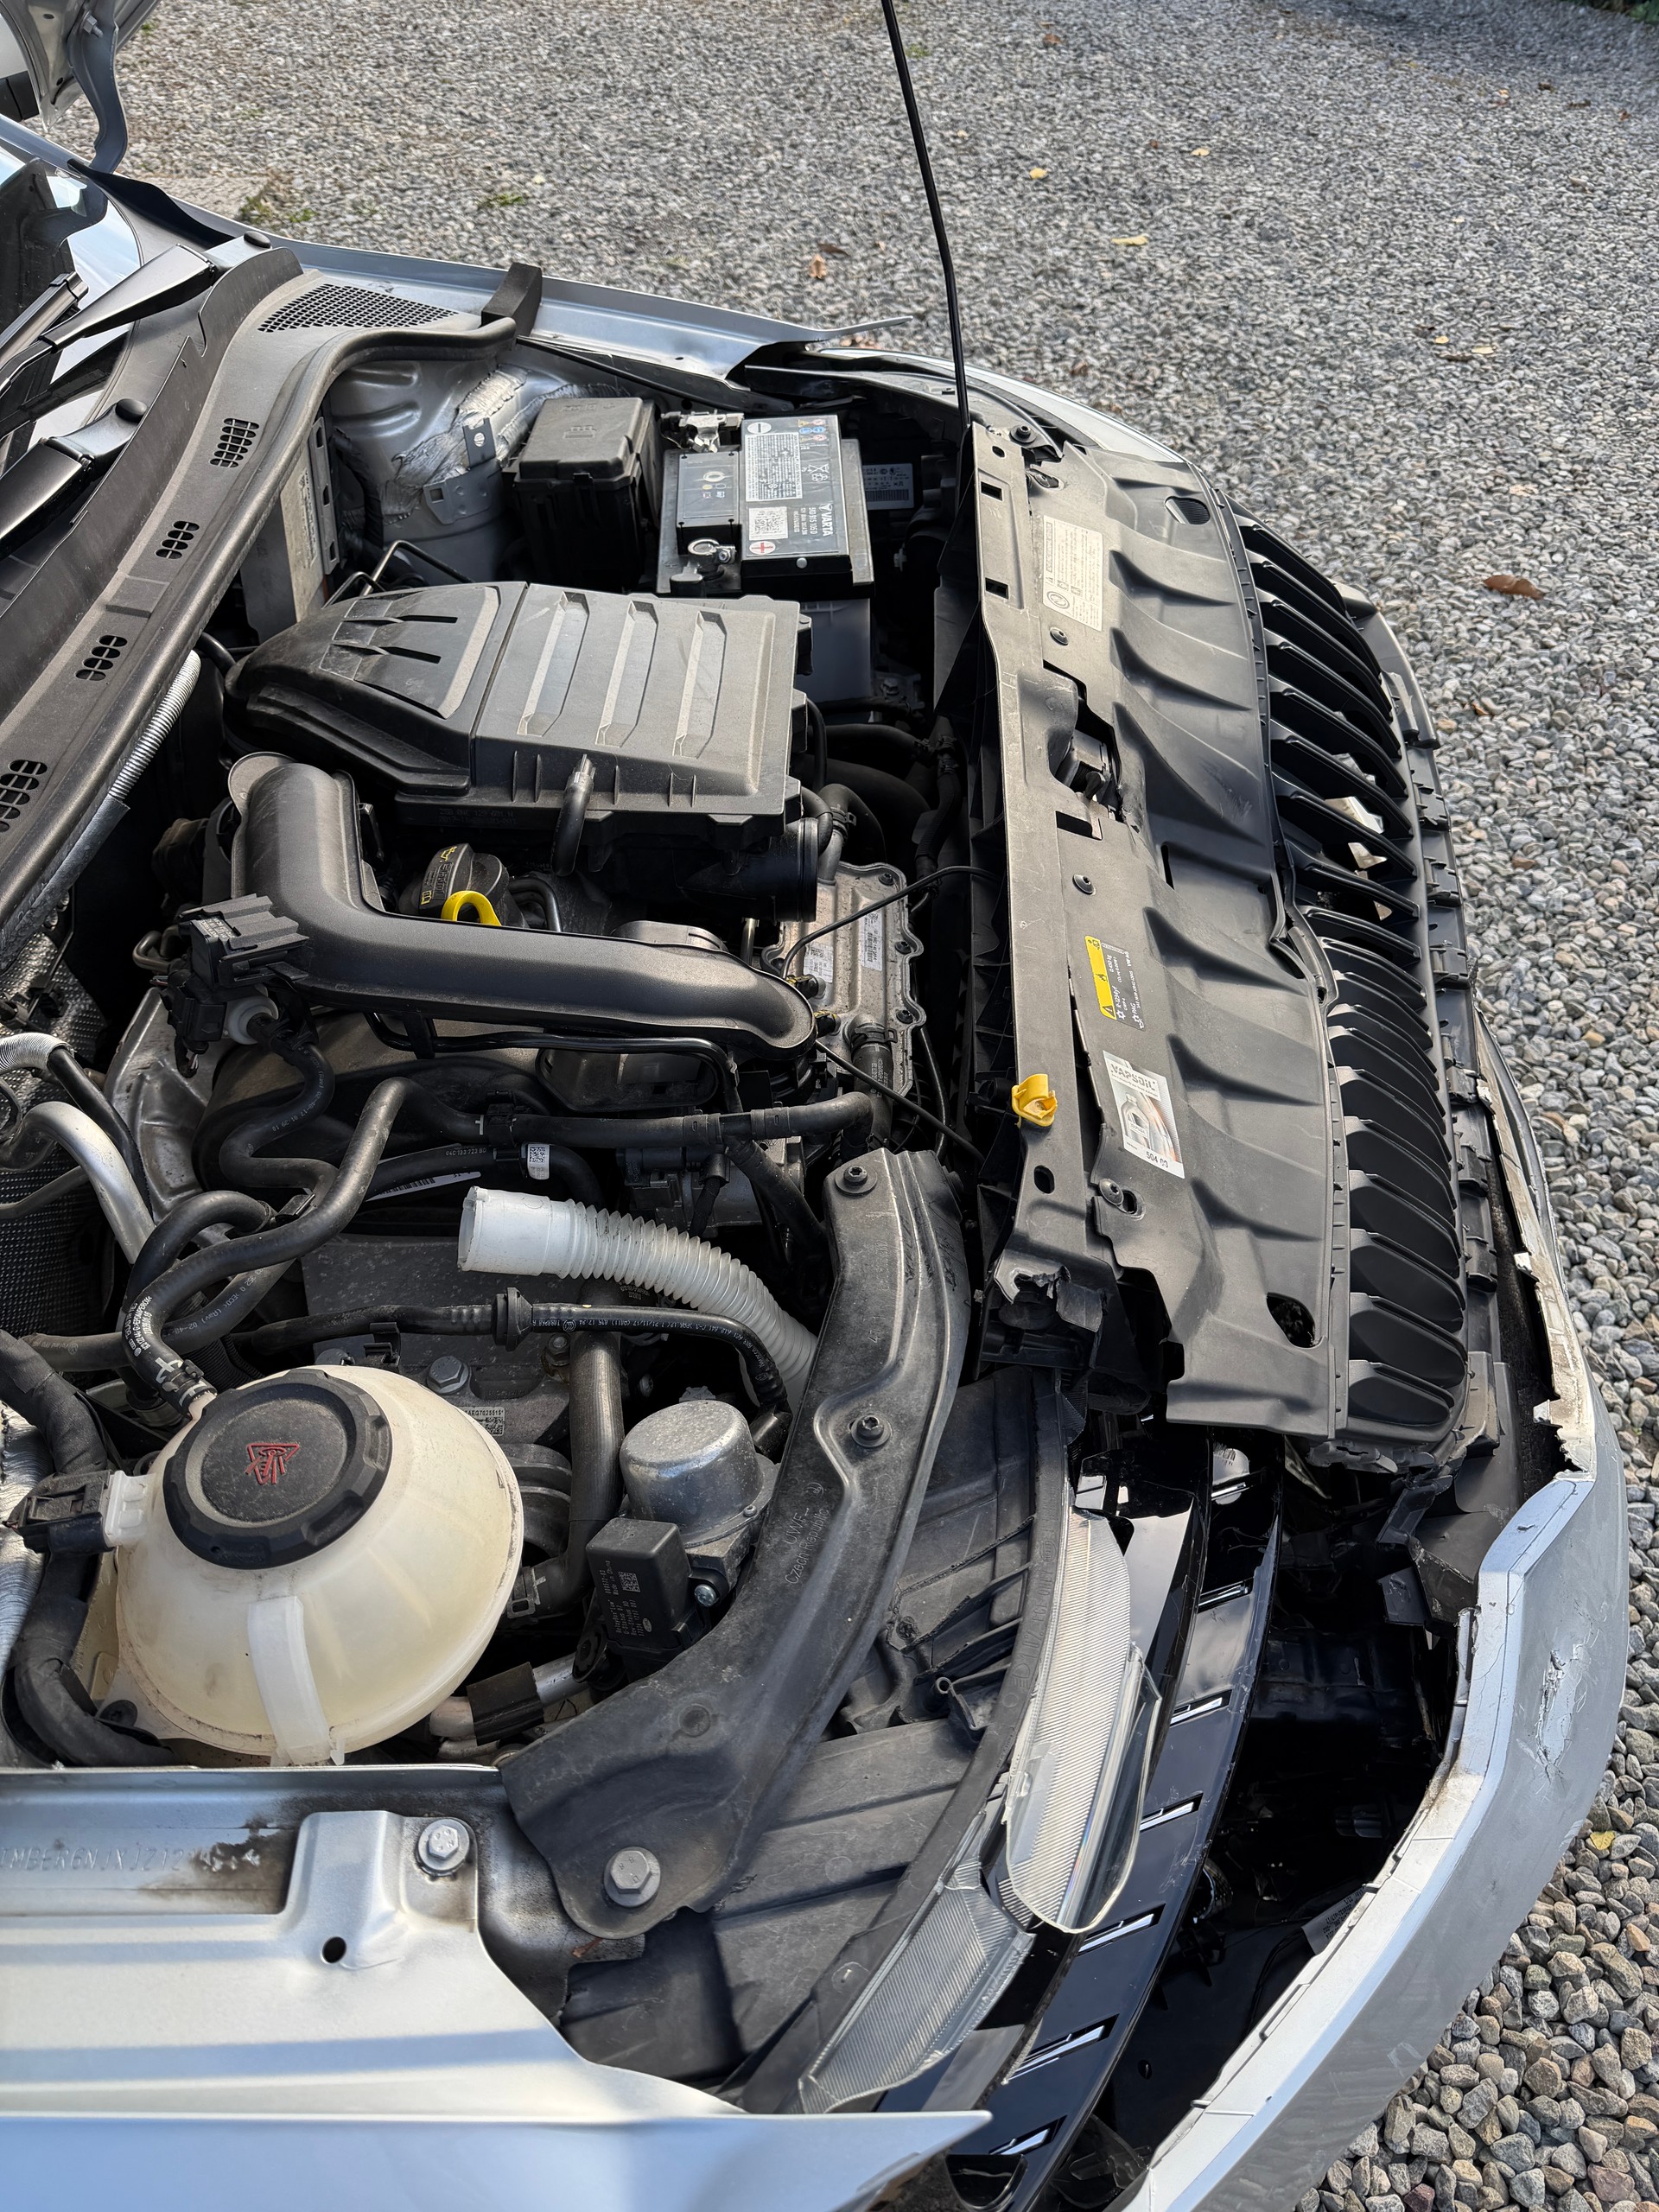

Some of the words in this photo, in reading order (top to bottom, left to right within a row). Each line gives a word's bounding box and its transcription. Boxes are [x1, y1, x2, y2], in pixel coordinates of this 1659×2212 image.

[821, 512, 834, 537] VARTA
[1146, 1151, 1159, 1163] 504
[785, 1553, 810, 1584] Czech
[799, 1508, 830, 1551] Republic
[1038, 1569, 1054, 1596] ONLY
[1033, 1605, 1046, 1623] ECE
